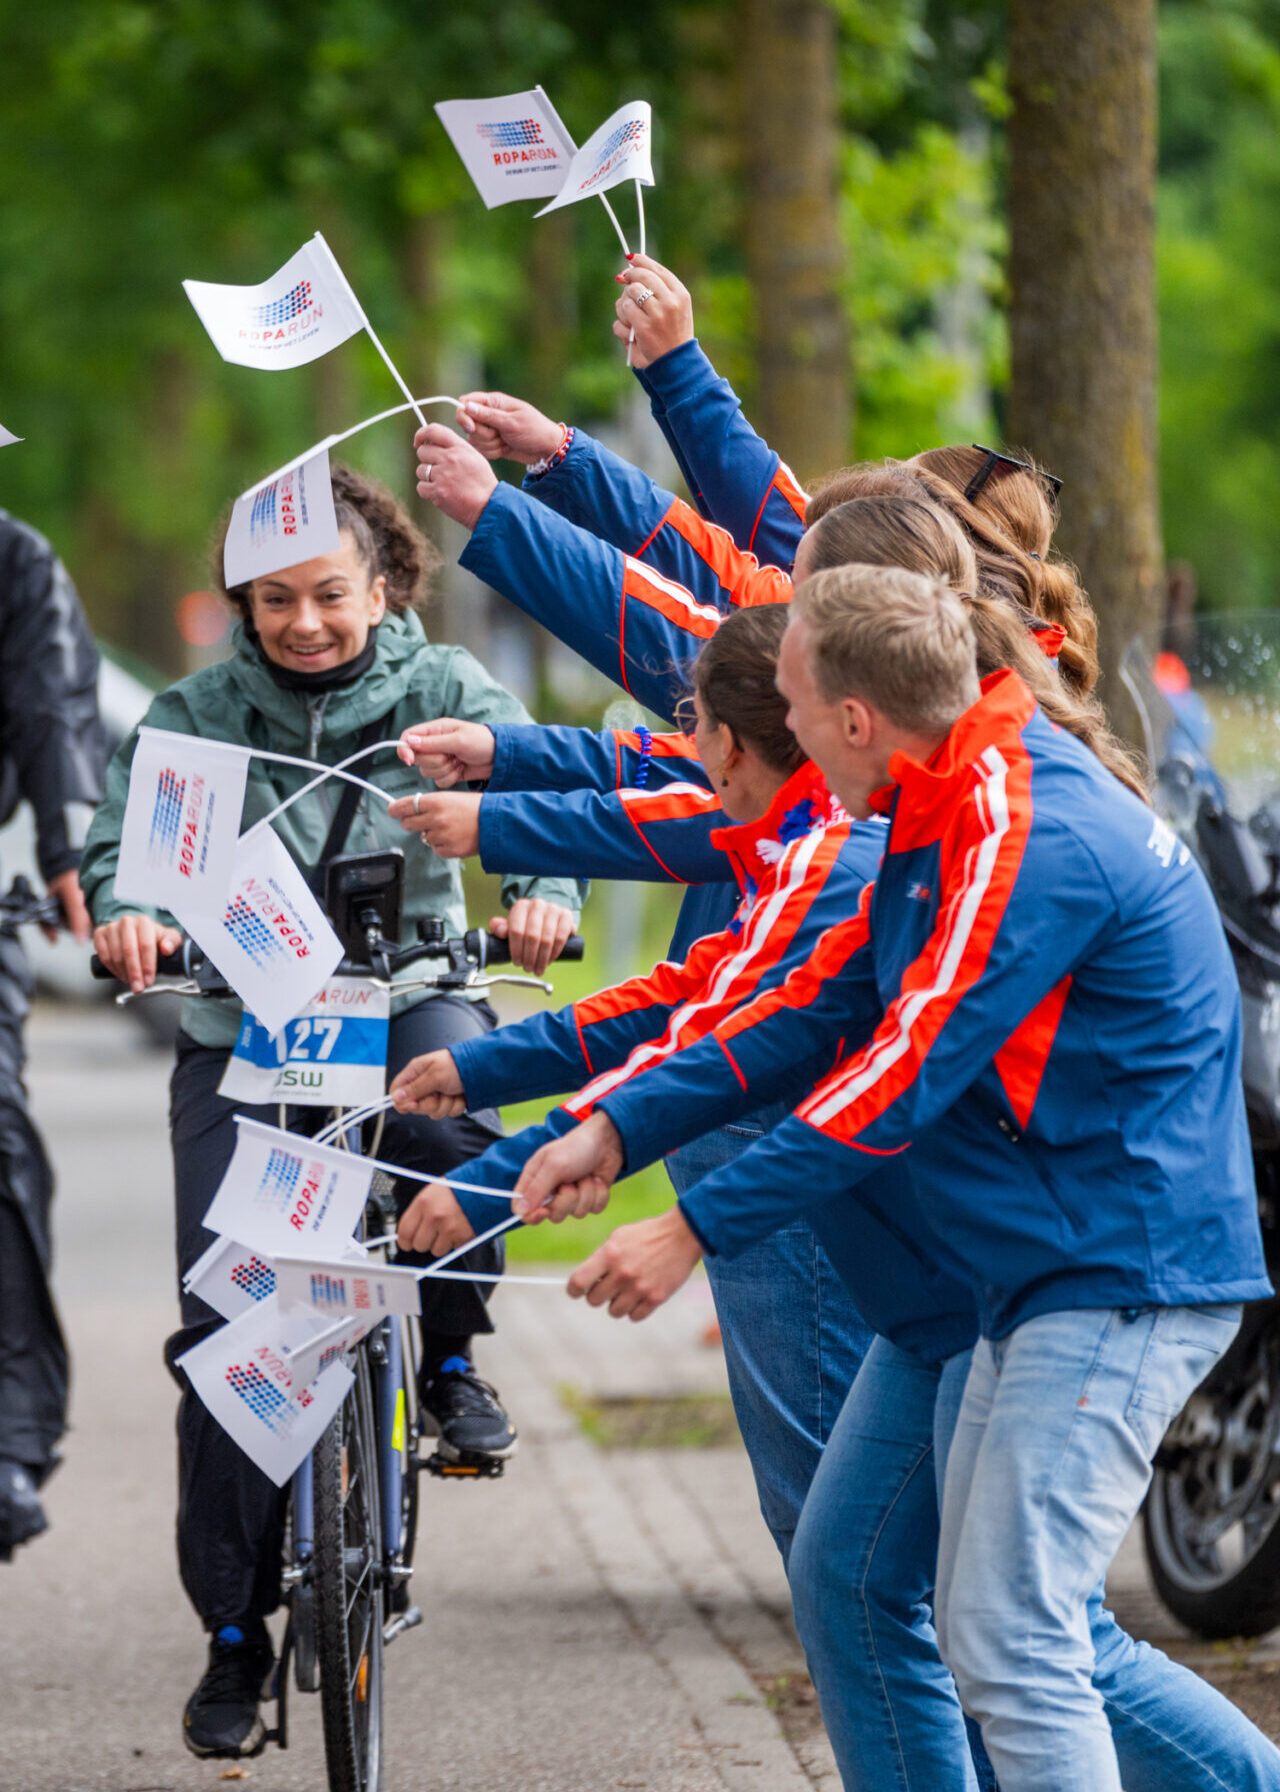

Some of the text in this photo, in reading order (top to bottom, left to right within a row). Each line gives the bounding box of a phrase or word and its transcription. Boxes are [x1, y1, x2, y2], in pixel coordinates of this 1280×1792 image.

[493, 146, 558, 167] ROPARUN
[179, 773, 205, 879] ROPARUN
[241, 878, 311, 958] ROPARUN
